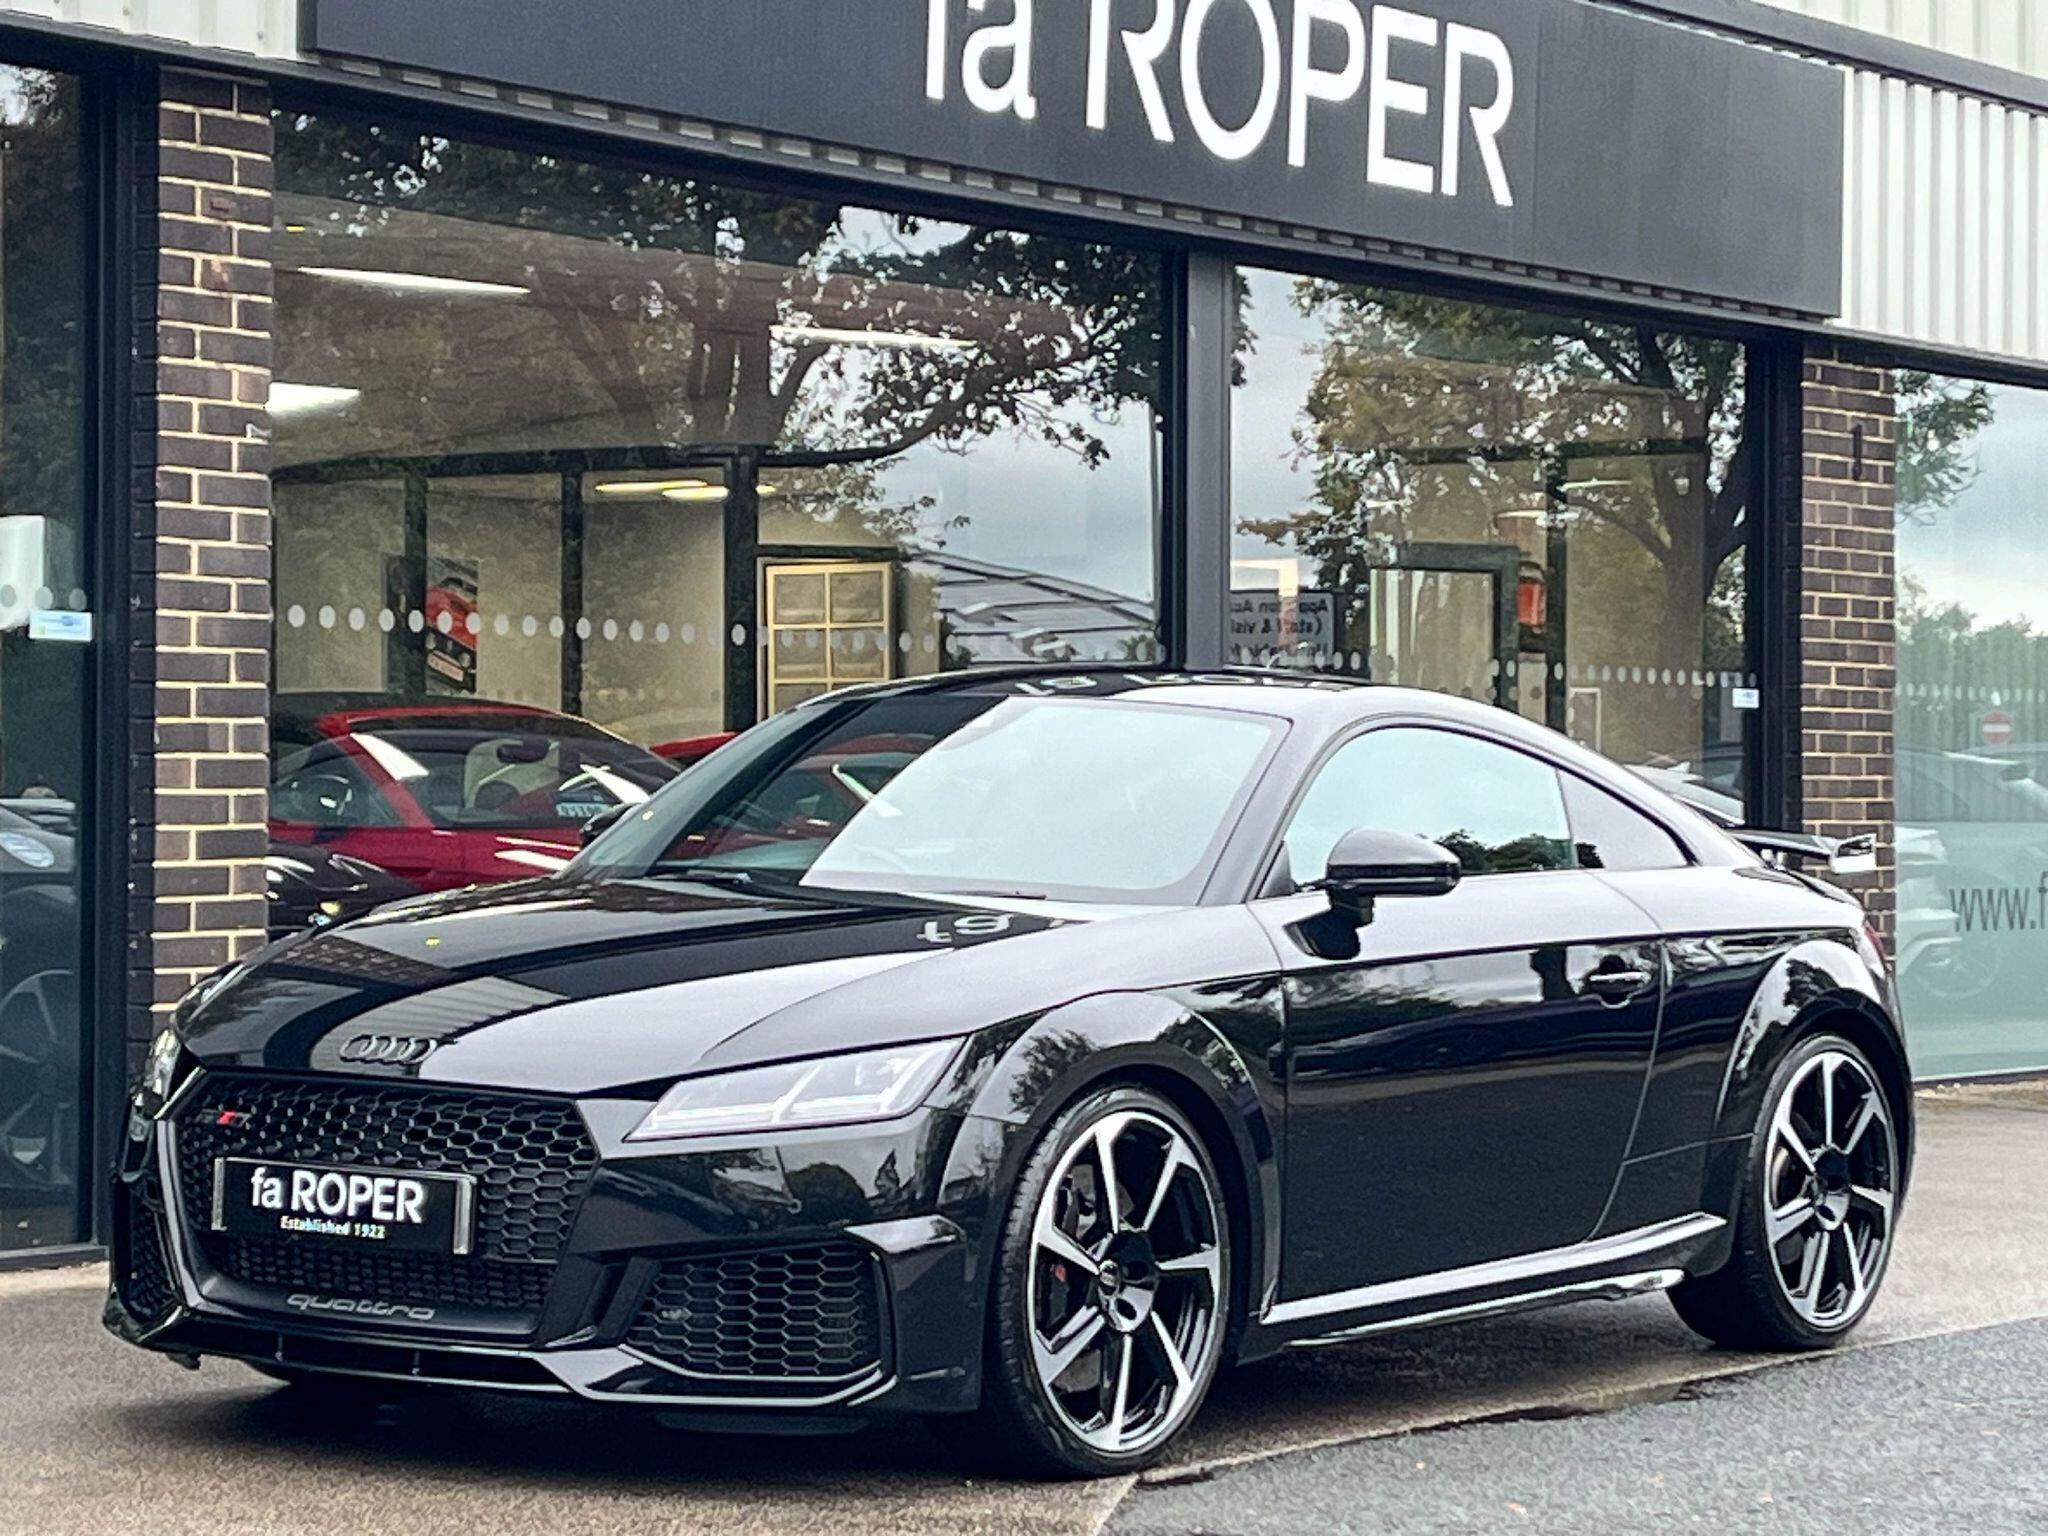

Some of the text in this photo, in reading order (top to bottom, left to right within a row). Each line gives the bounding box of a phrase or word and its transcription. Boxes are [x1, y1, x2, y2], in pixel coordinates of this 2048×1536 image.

[1085, 0, 1514, 207] ROPER
[250, 1167, 425, 1224] fa ROPER
[280, 1215, 350, 1236] Established
[286, 1293, 436, 1321] quattro
